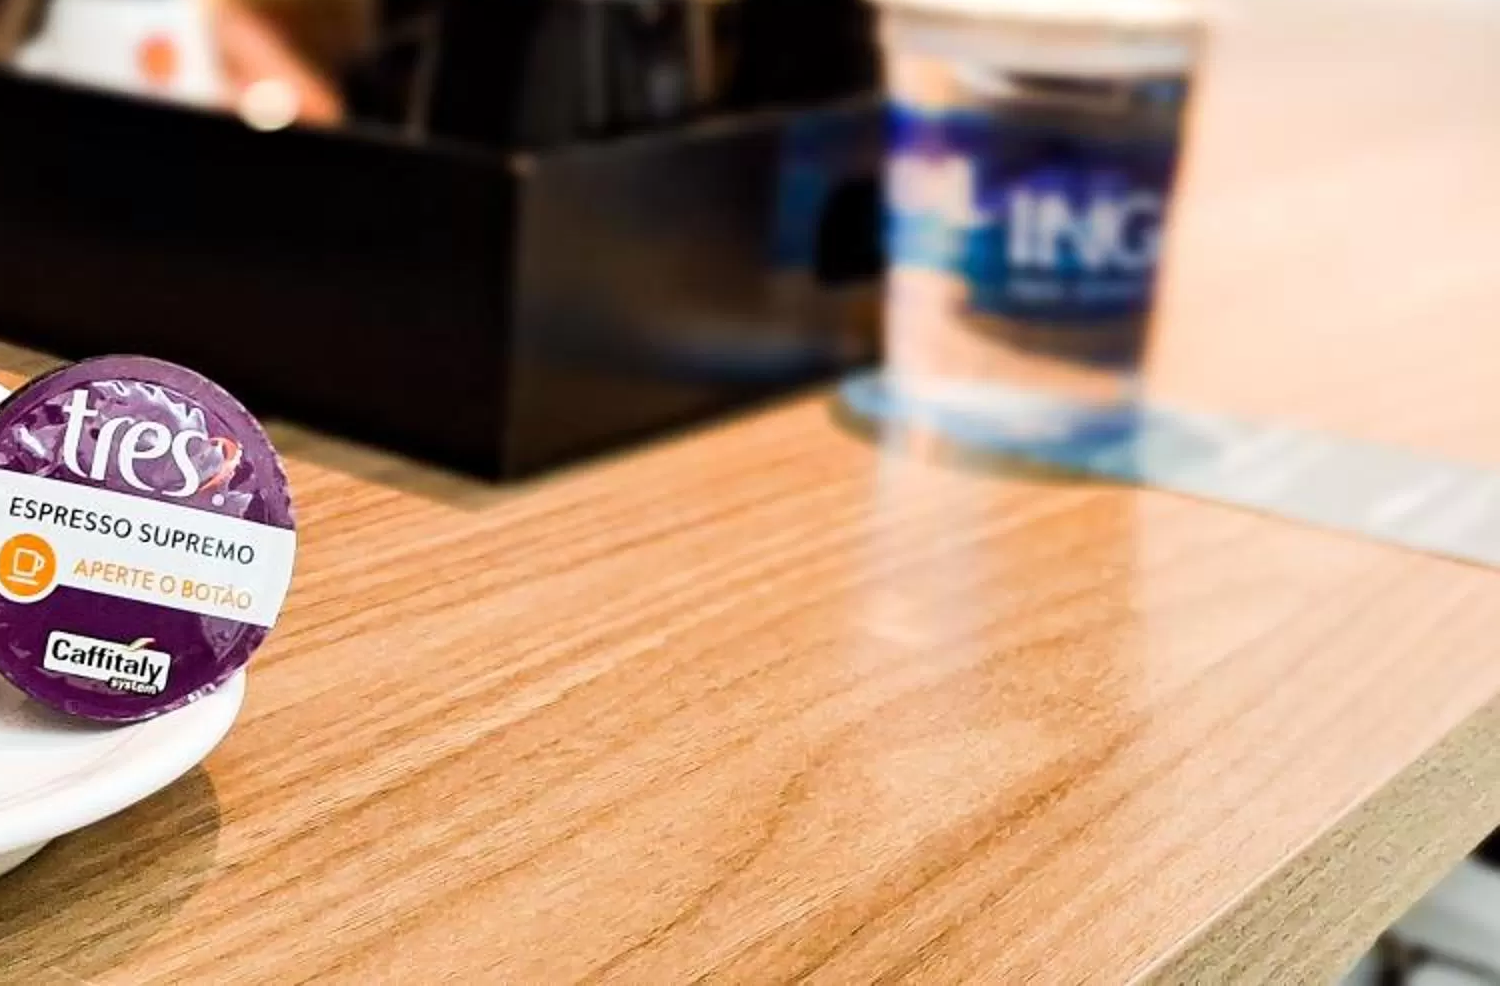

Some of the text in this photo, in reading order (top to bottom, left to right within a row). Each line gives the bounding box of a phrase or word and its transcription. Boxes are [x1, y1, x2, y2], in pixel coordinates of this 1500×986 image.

[61, 388, 209, 497] tres
[8, 496, 255, 565] ESPRESSO SUPREMO
[73, 558, 252, 610] APERTE O BOTÃO
[51, 638, 163, 685] Caffitaly
[109, 677, 157, 695] system
